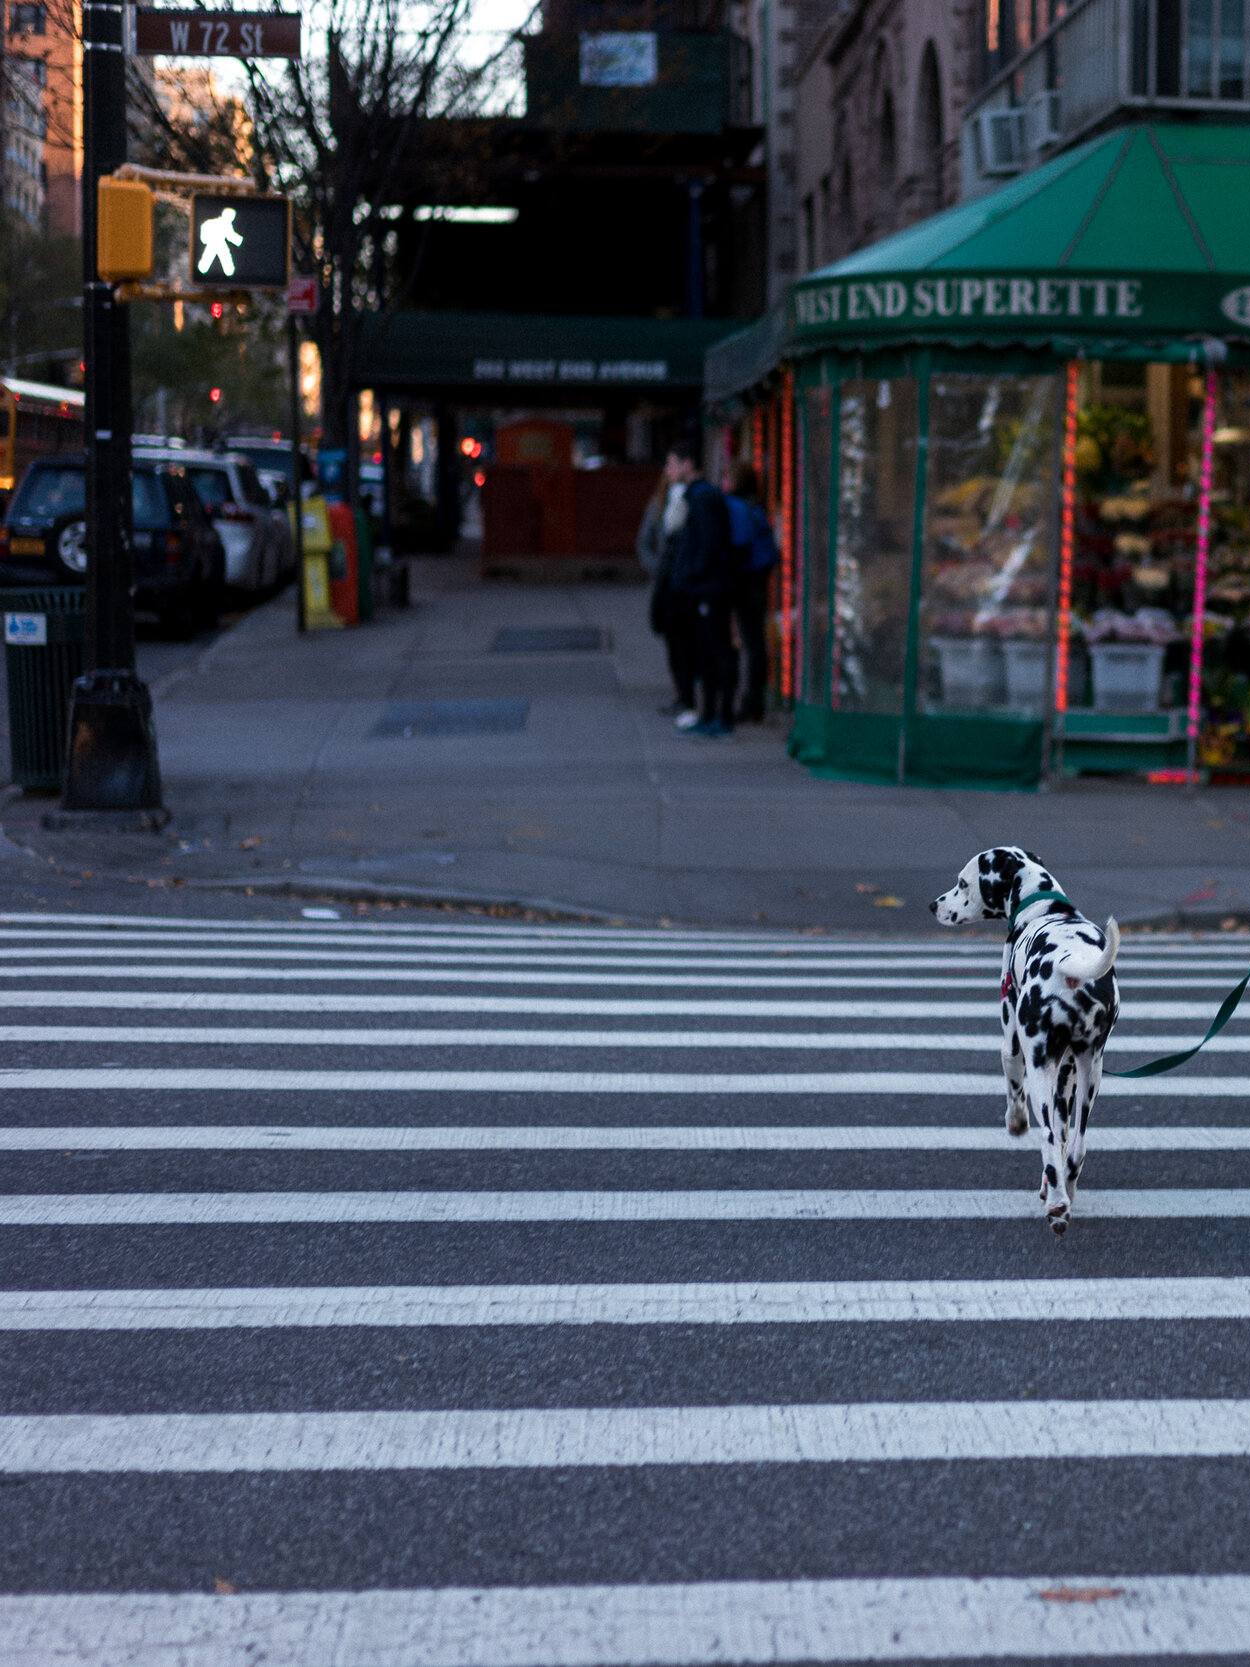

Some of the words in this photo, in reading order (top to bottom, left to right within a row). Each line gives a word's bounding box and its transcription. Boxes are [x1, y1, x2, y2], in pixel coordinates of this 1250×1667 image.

[169, 20, 190, 52] W
[199, 21, 230, 54] 72
[239, 22, 264, 55] St
[848, 281, 907, 321] END
[912, 278, 1144, 318] SUPERETTE
